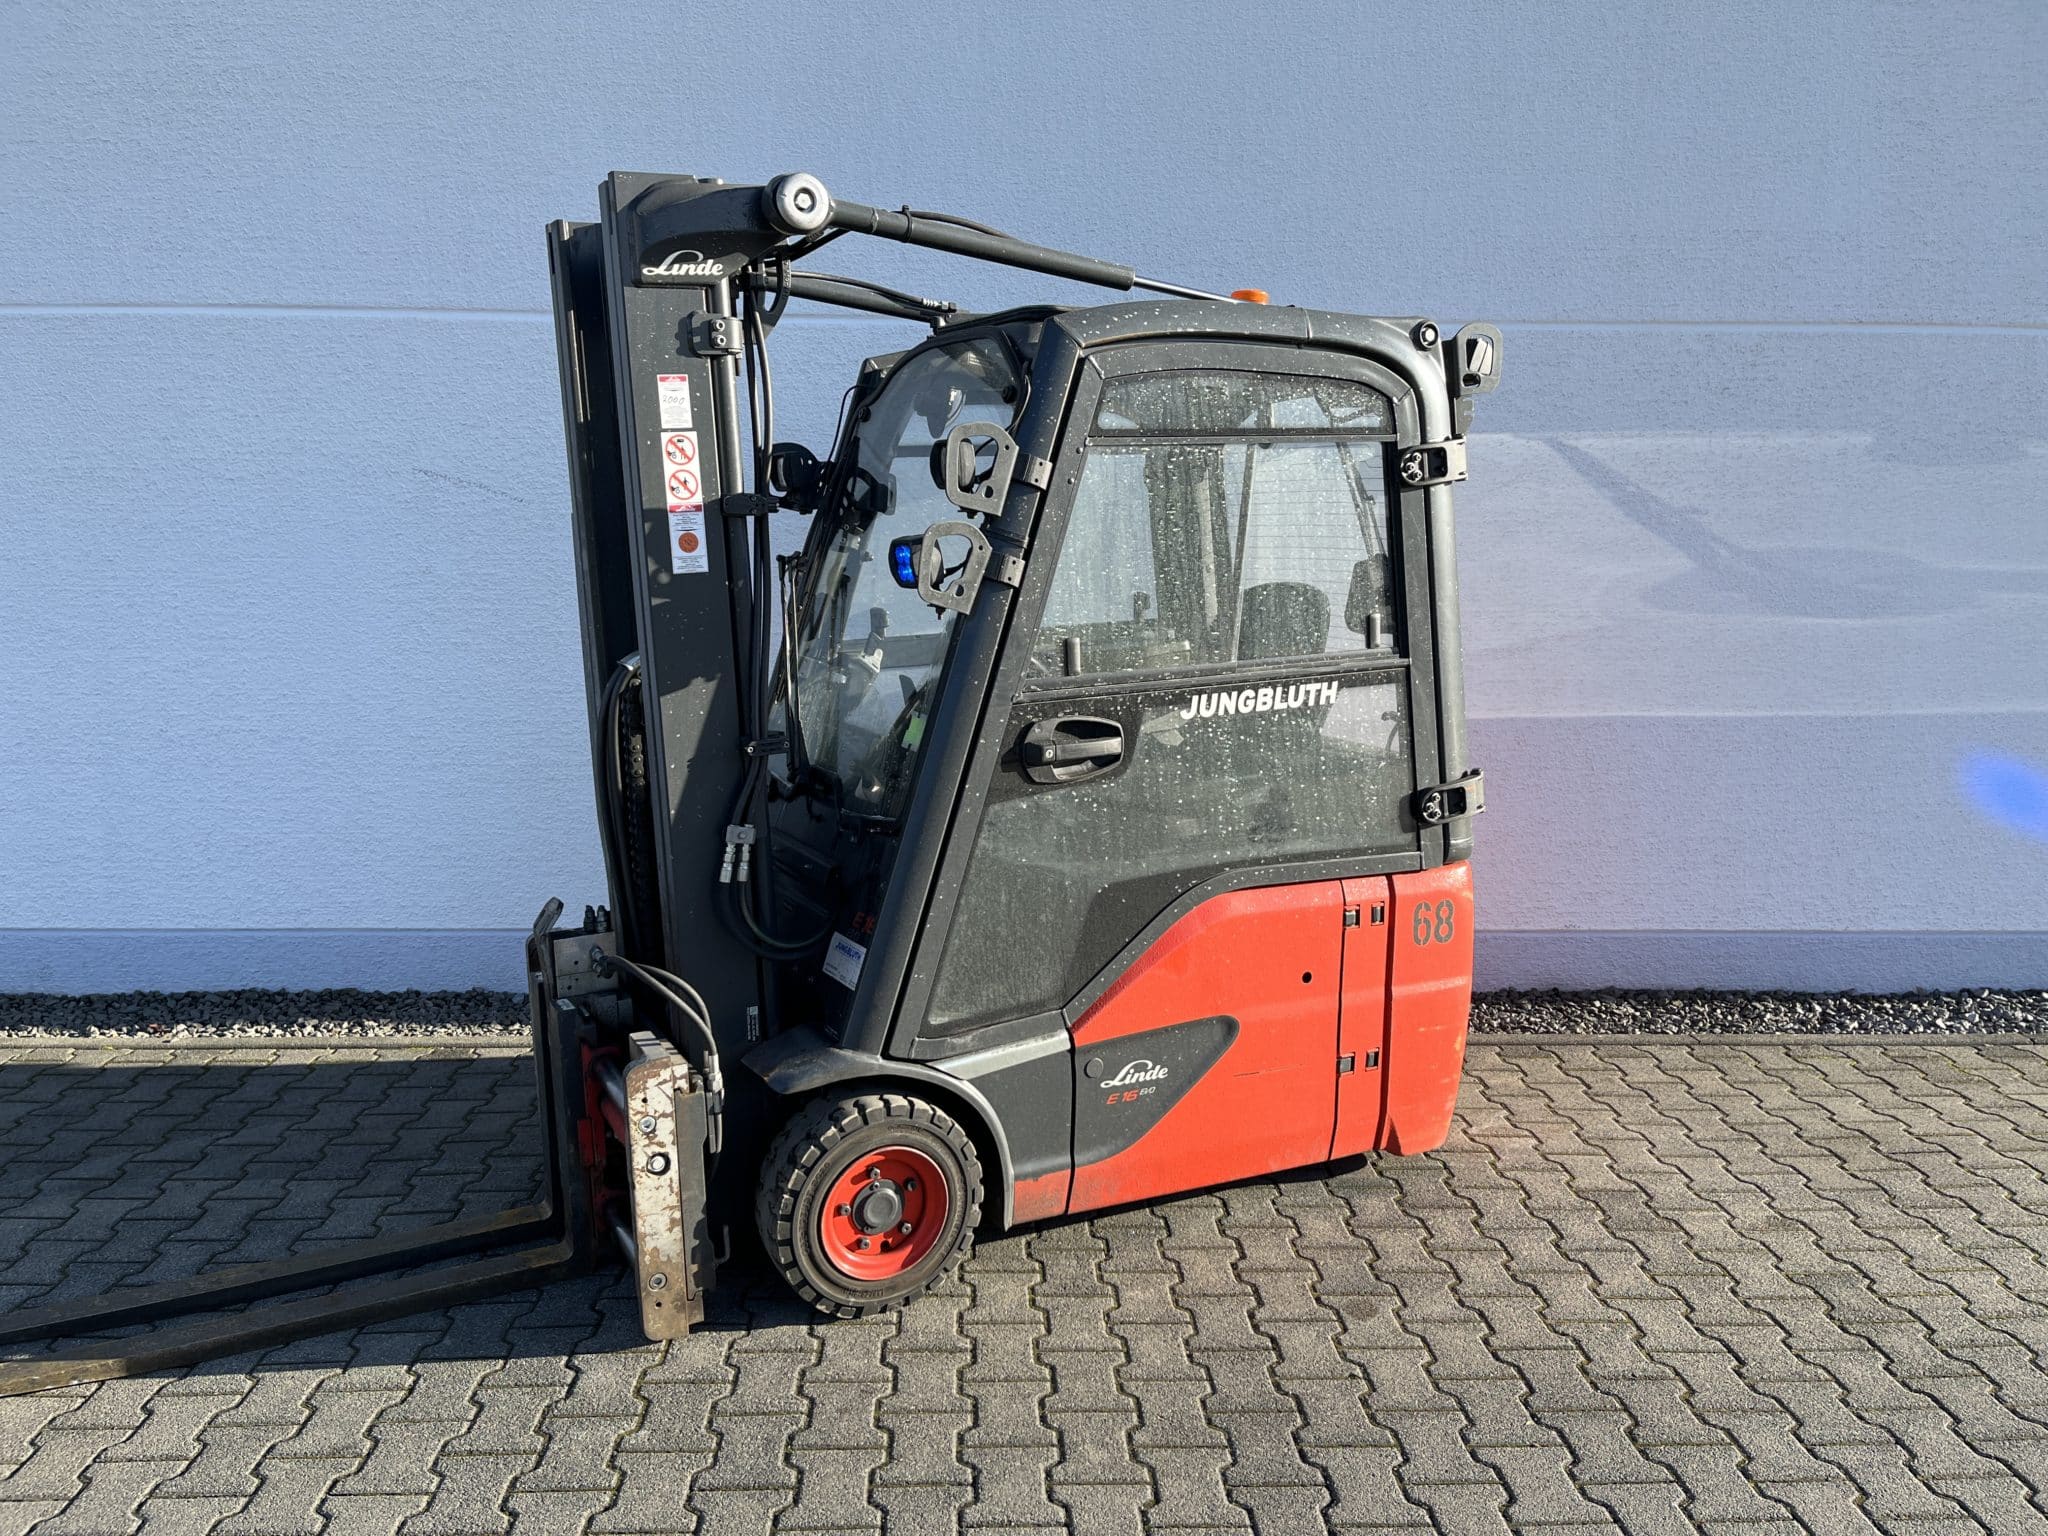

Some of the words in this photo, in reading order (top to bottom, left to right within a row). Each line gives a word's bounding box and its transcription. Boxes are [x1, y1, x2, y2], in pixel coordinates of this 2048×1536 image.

[642, 250, 723, 275] Linde
[662, 394, 686, 406] 2000
[1180, 681, 1338, 720] JUNGBLUTH
[1413, 899, 1454, 946] 68
[1100, 1060, 1169, 1088] Linde
